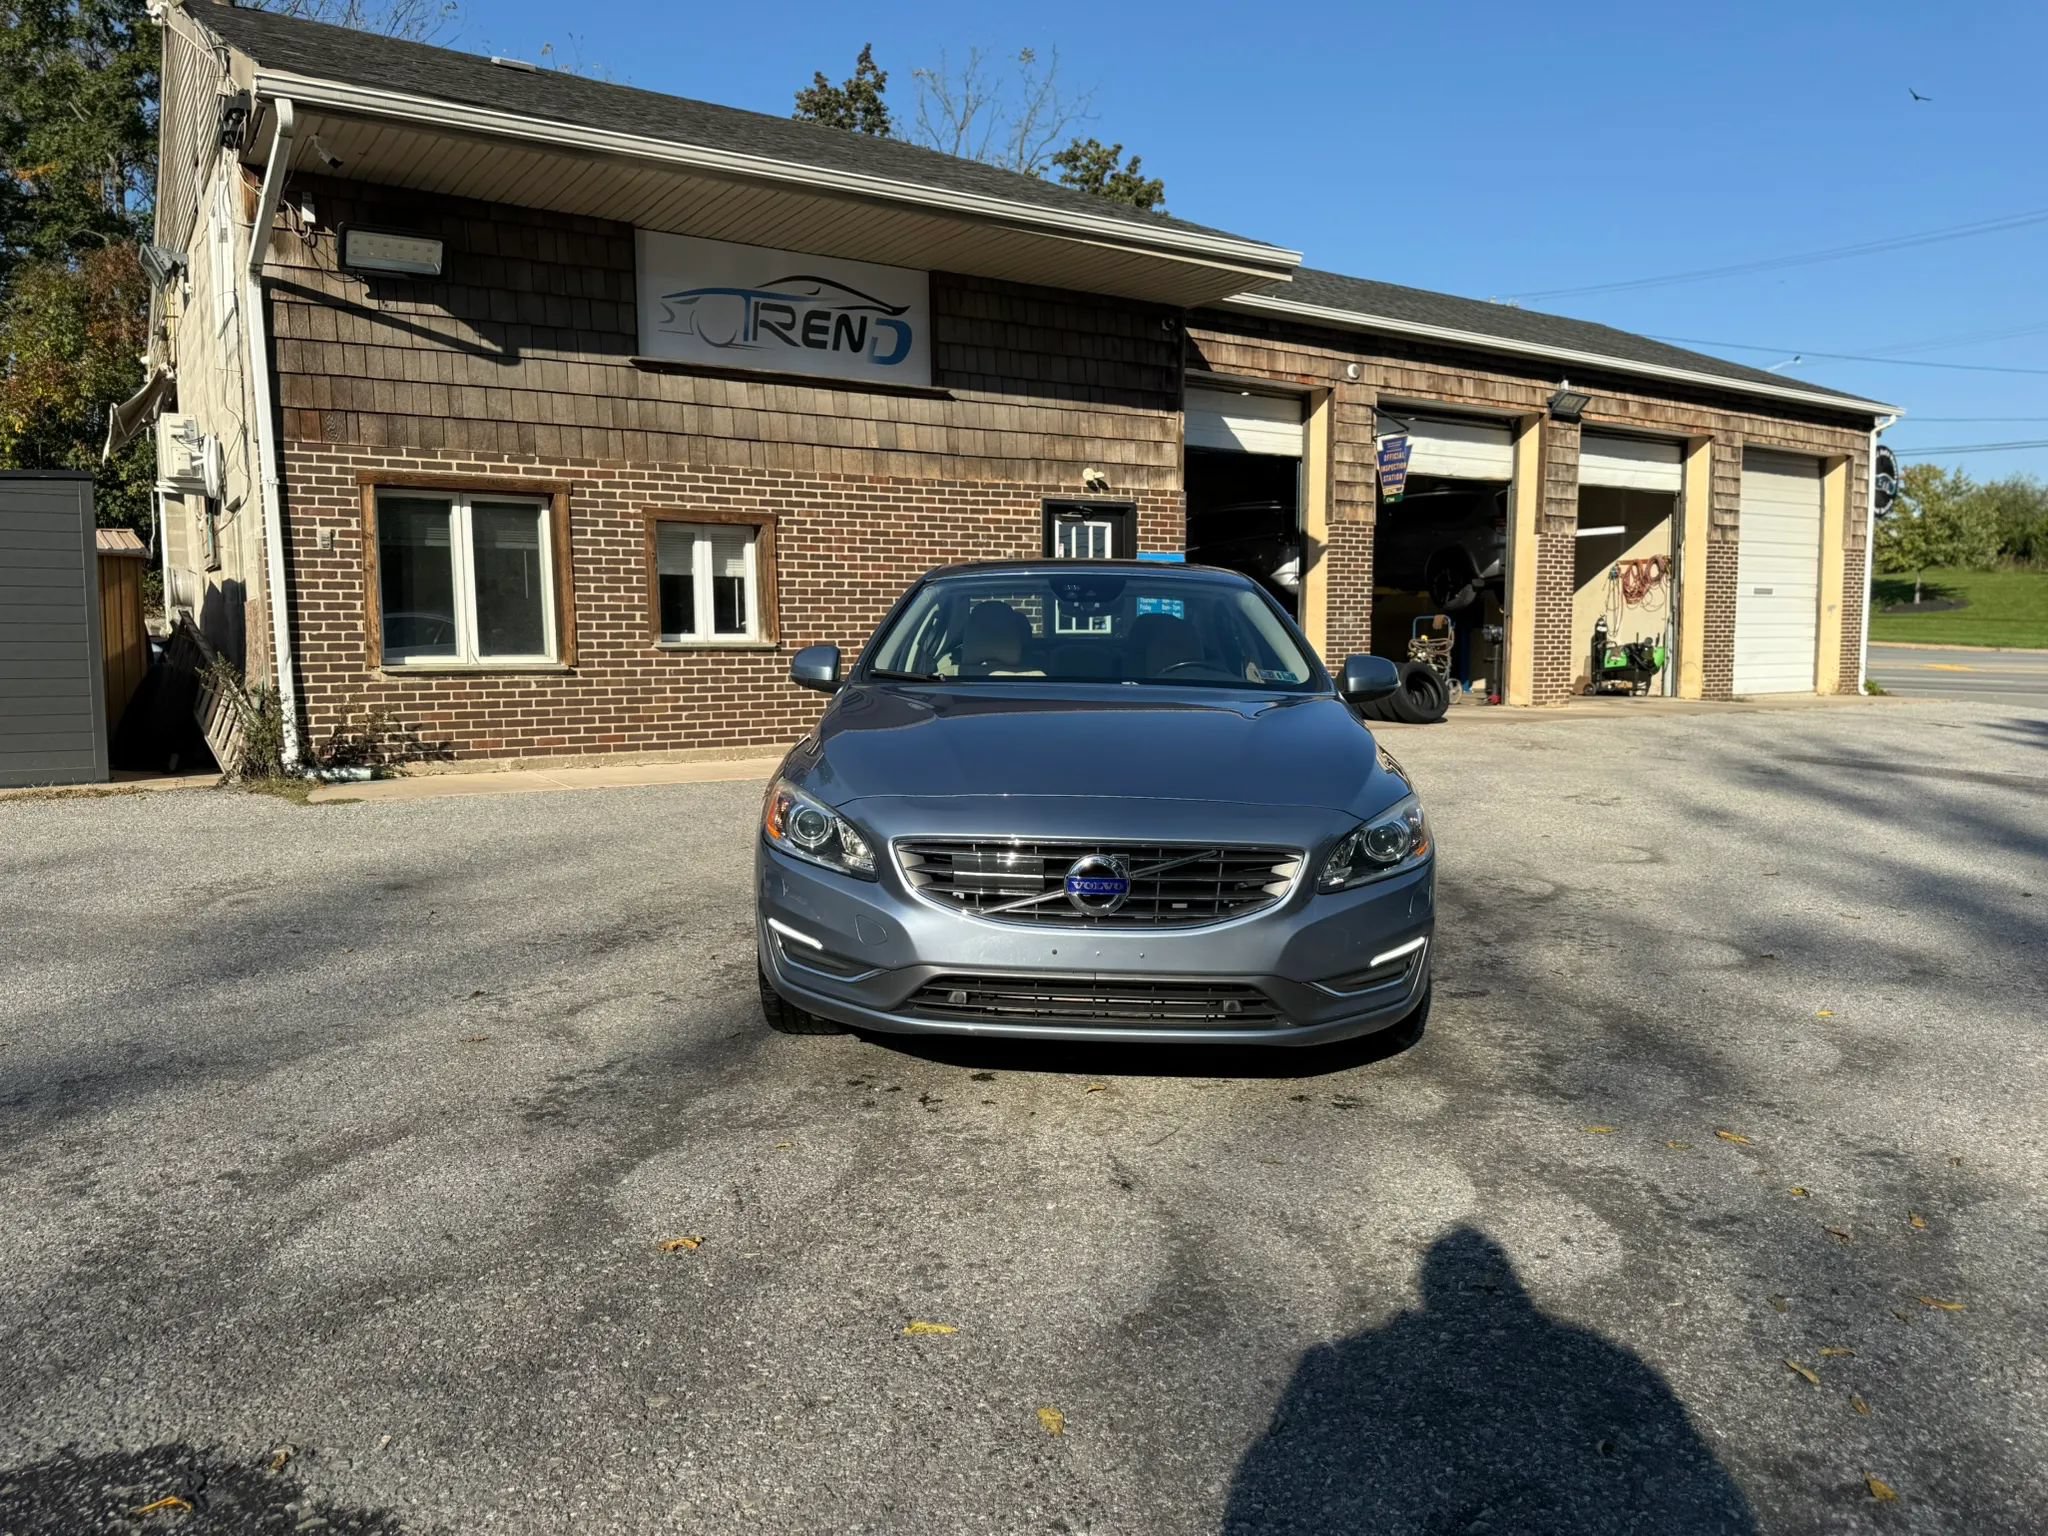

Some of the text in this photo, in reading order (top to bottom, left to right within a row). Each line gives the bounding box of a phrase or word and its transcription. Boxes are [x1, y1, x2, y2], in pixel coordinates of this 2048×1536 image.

[738, 288, 913, 366] TREND
[1384, 452, 1405, 462] OFFICIAL
[1380, 462, 1407, 472] INSPECTION
[1383, 473, 1403, 482] STATION
[1139, 603, 1152, 611] Friday
[1071, 881, 1123, 891] VOLVO
